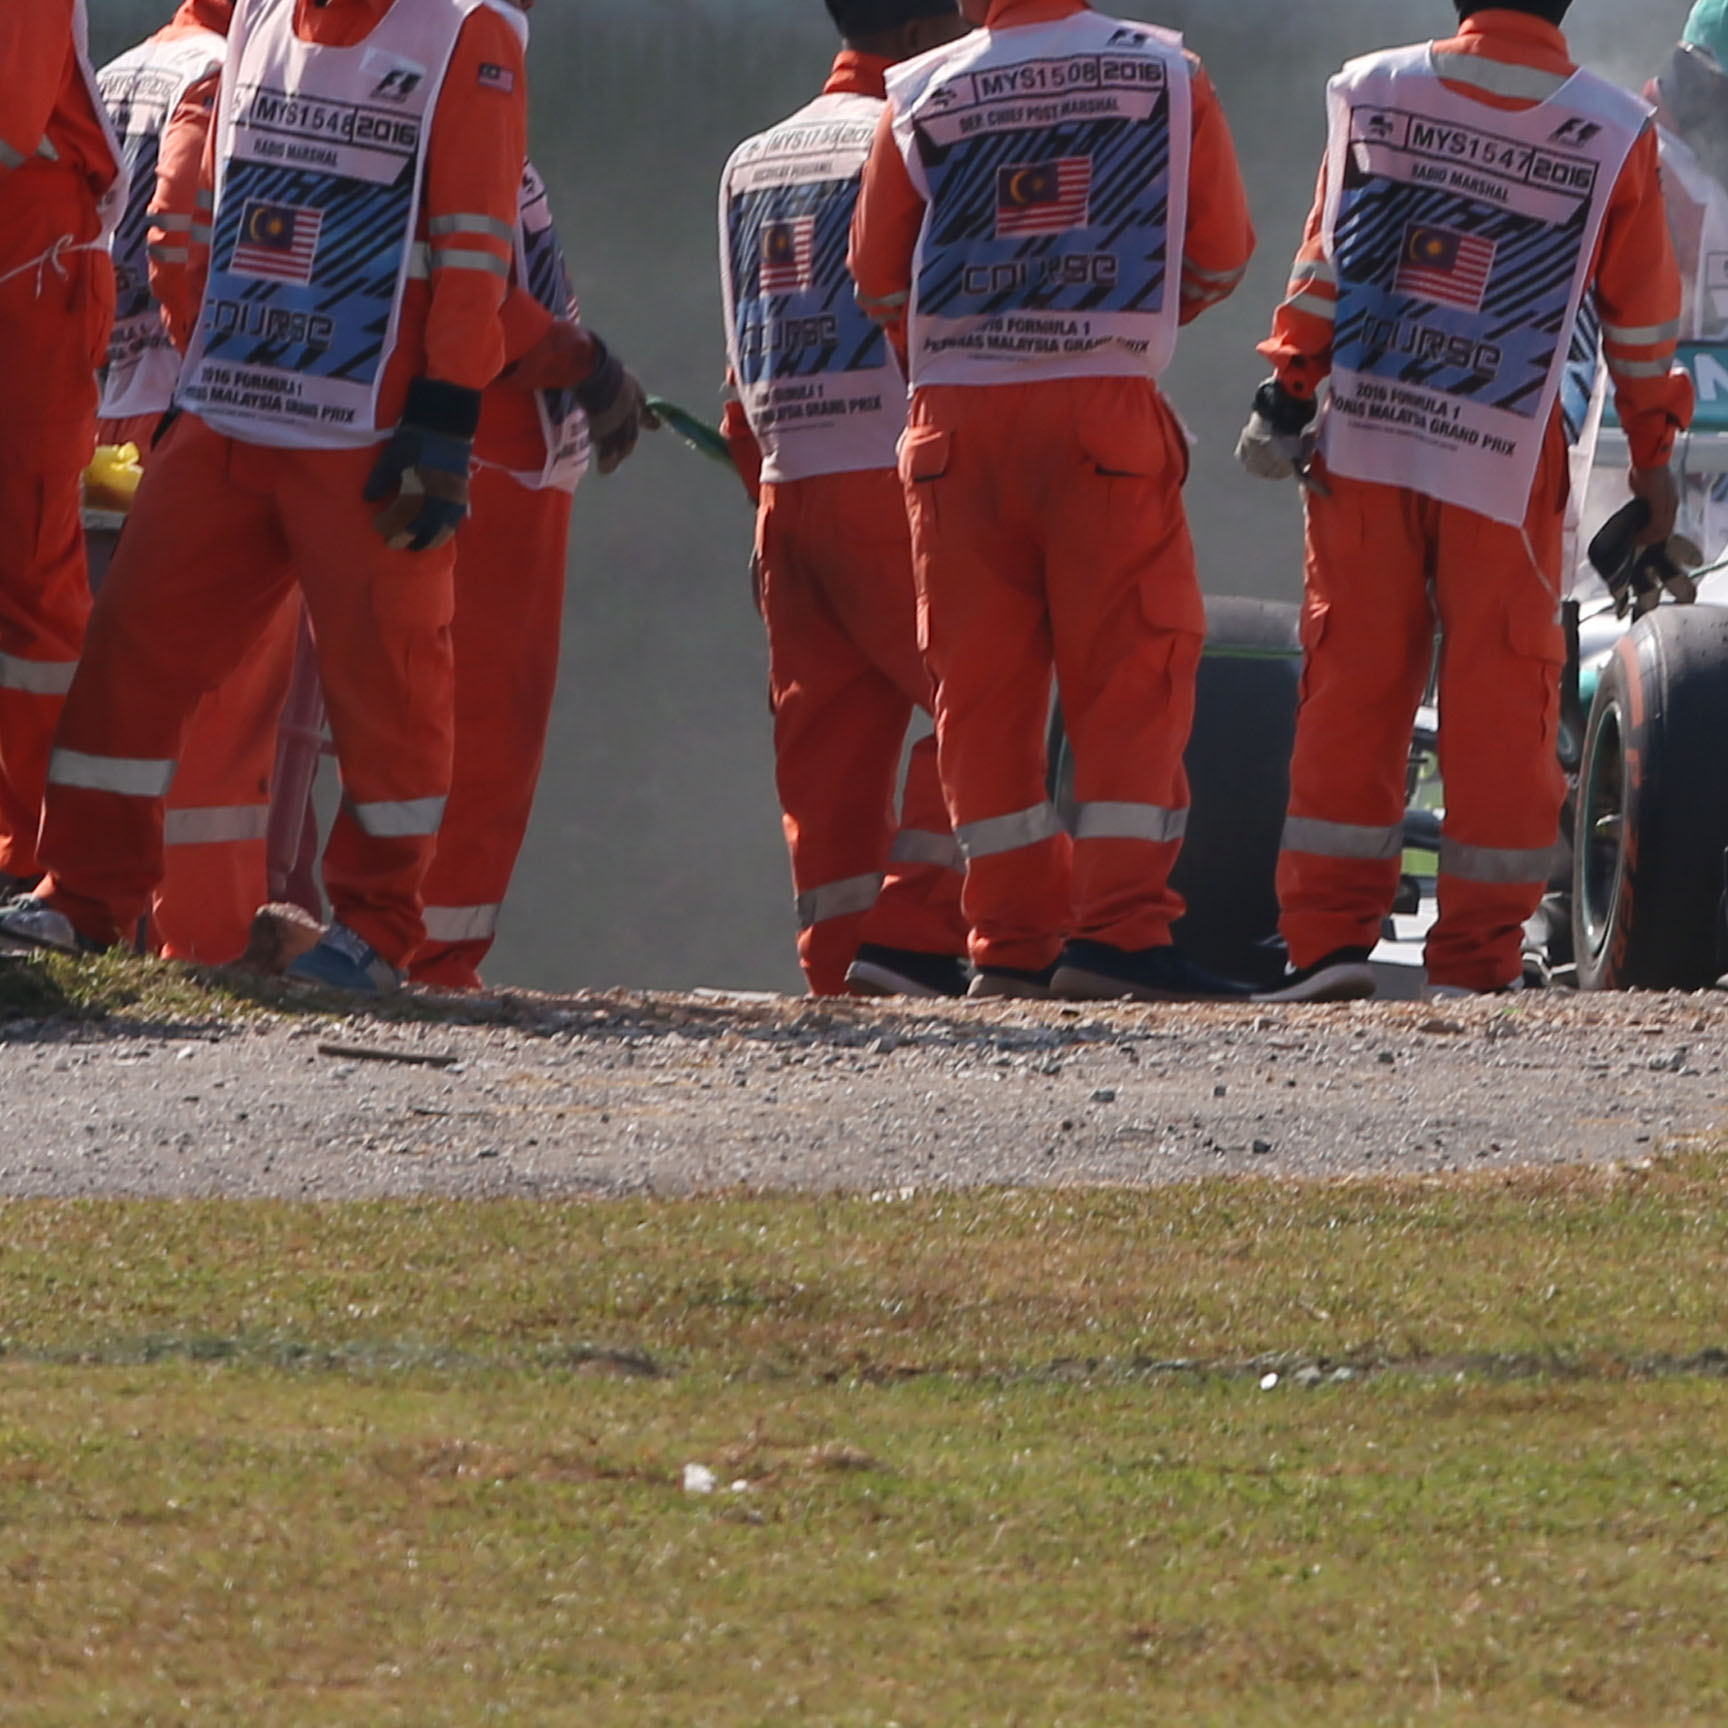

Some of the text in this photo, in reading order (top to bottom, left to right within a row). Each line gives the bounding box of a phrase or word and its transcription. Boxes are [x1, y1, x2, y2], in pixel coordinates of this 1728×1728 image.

[369, 68, 423, 103] F1
[982, 61, 1163, 97] MYS1508 2016
[1059, 96, 1120, 118] MARSHAL
[355, 116, 417, 147] 2016
[841, 127, 872, 145] 201
[1548, 117, 1603, 148] F1
[254, 137, 338, 167] RADIO MARSHAL
[1412, 124, 1591, 189] MYS1547 2016
[1410, 163, 1510, 203] RADIO MARSHAL
[1006, 318, 1079, 335] FORMULA
[1082, 322, 1091, 335] 1
[986, 335, 1059, 353] MALAYSIA
[233, 369, 297, 393] FORMULA
[297, 383, 303, 397] 1
[210, 386, 282, 413] MALAYSIA
[322, 402, 357, 425] PRIX
[848, 394, 882, 414] PRIX
[1357, 381, 1461, 420] 2016 FORMULA 1
[1367, 402, 1427, 429] MALAYSIA
[1429, 416, 1479, 445] GRAND
[1481, 431, 1518, 457] PRIX
